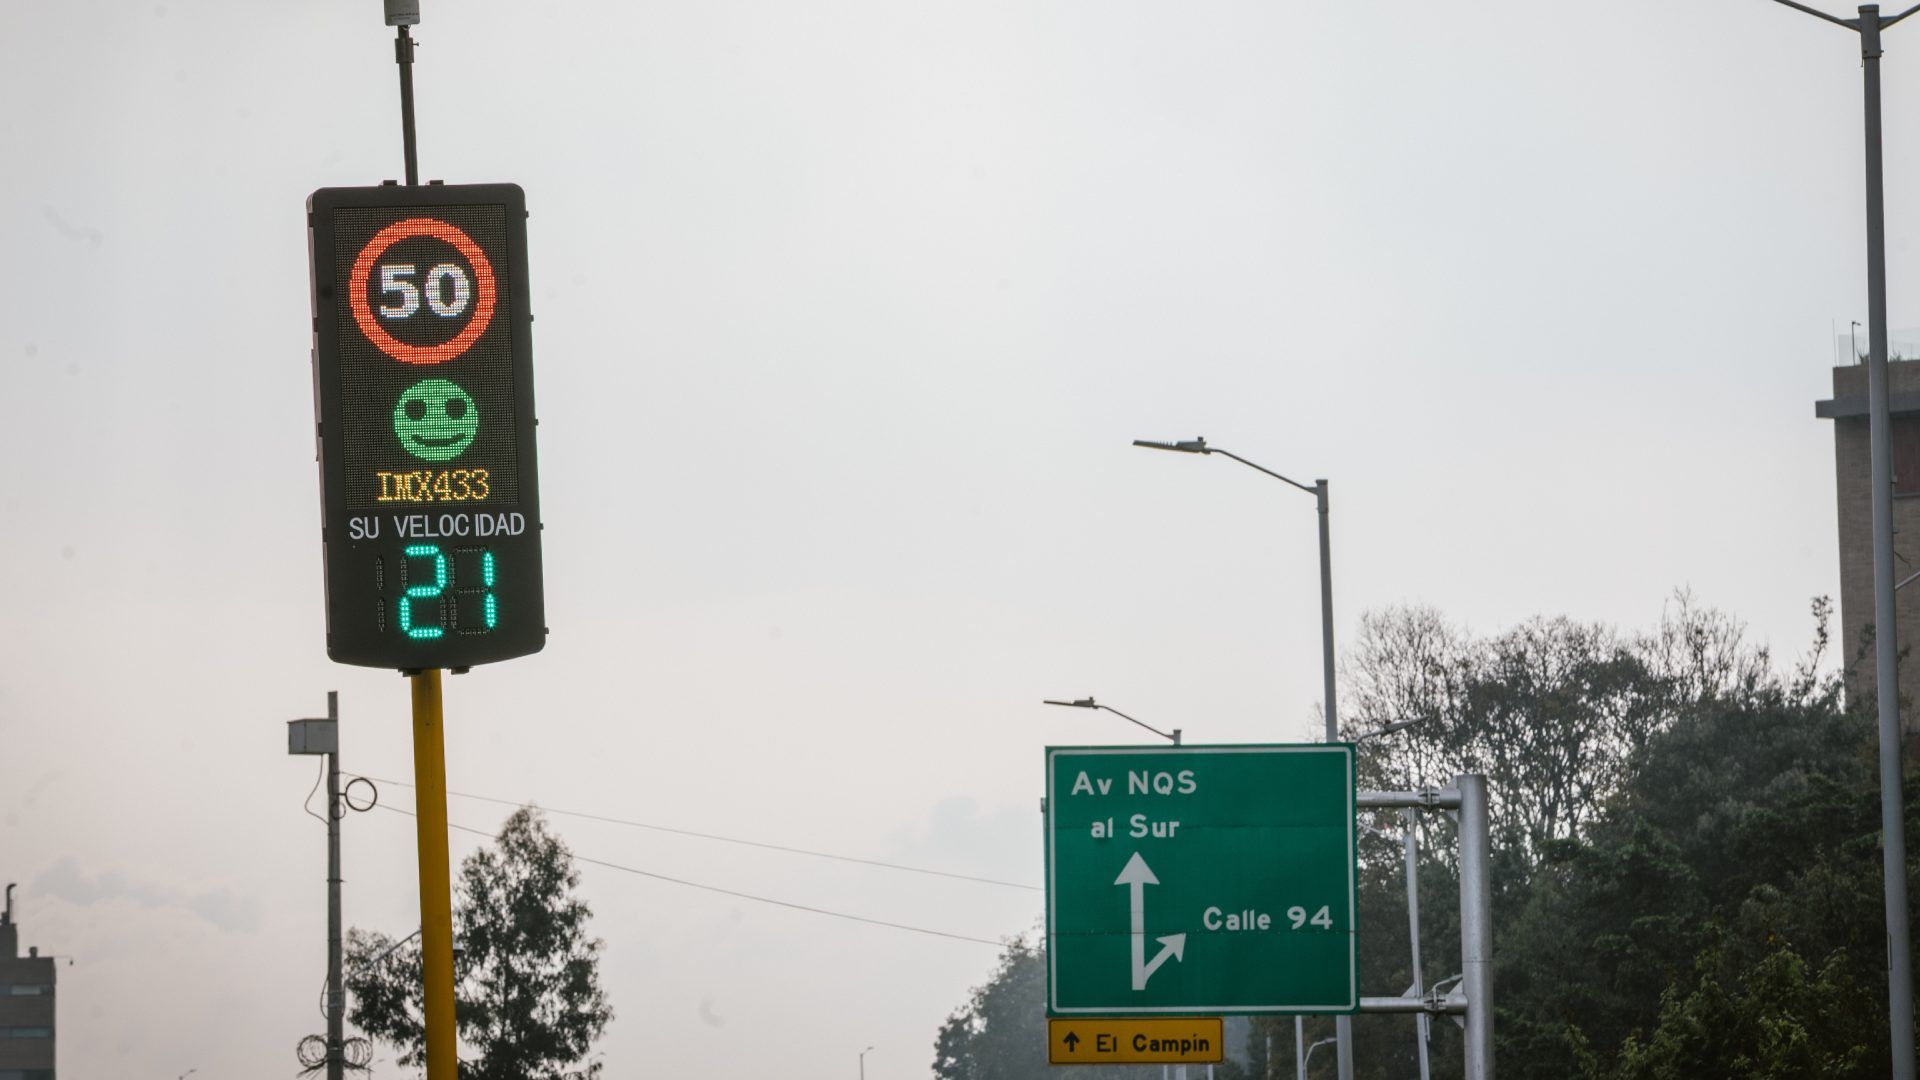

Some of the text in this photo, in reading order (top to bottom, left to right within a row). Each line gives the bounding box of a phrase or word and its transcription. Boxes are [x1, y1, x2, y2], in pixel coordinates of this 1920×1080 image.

[380, 264, 470, 318] 50
[377, 469, 490, 501] IMX433
[350, 512, 525, 540] SU VELOCIDAD
[399, 545, 496, 638] 21
[1071, 770, 1197, 796] Av NQS
[1090, 814, 1180, 838] al Sur
[1203, 905, 1333, 931] Calle 94
[1096, 1033, 1210, 1056] El Campin
